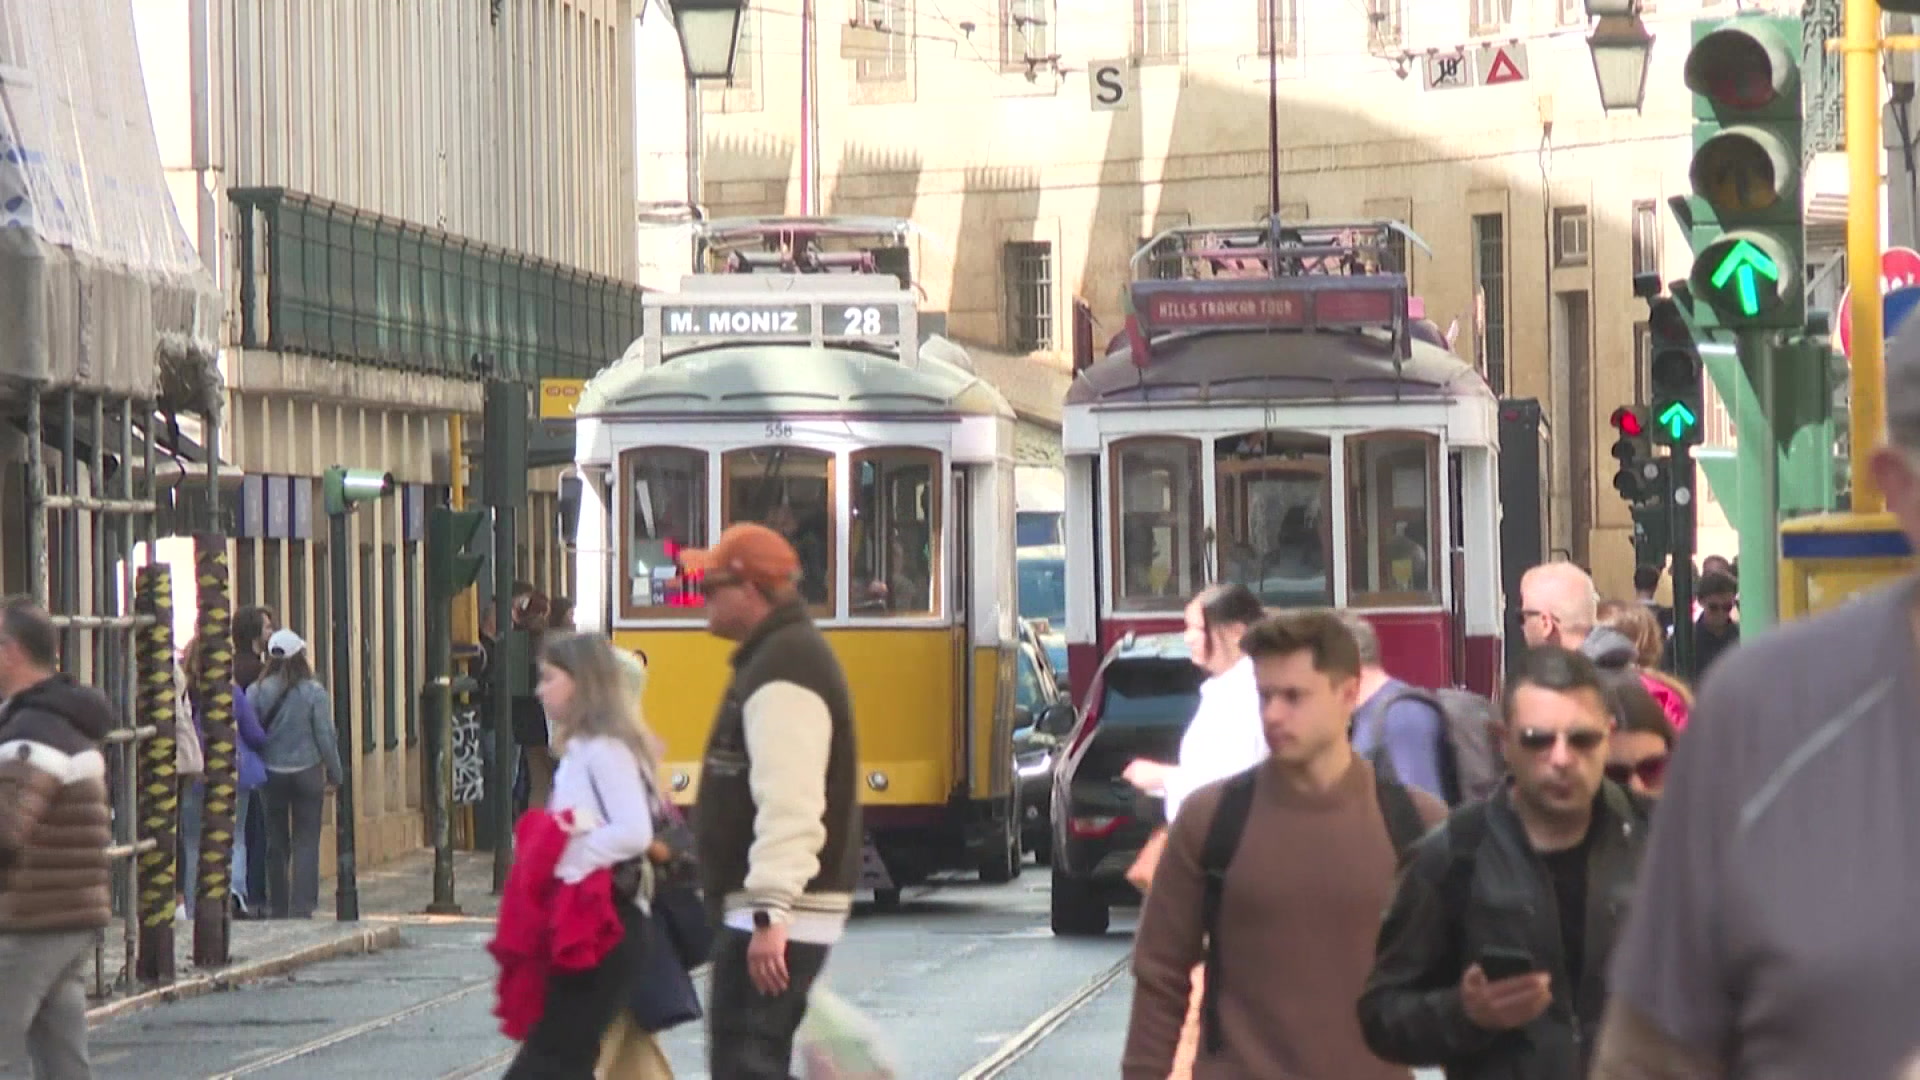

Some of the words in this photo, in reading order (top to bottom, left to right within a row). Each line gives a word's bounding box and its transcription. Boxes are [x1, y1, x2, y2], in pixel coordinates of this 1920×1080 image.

[1096, 66, 1123, 104] S
[1159, 302, 1197, 318] HILLS
[1260, 299, 1293, 315] TOUR
[670, 311, 700, 332] M.
[709, 311, 798, 332] MONIZ
[843, 307, 881, 336] 28
[765, 423, 793, 438] 558
